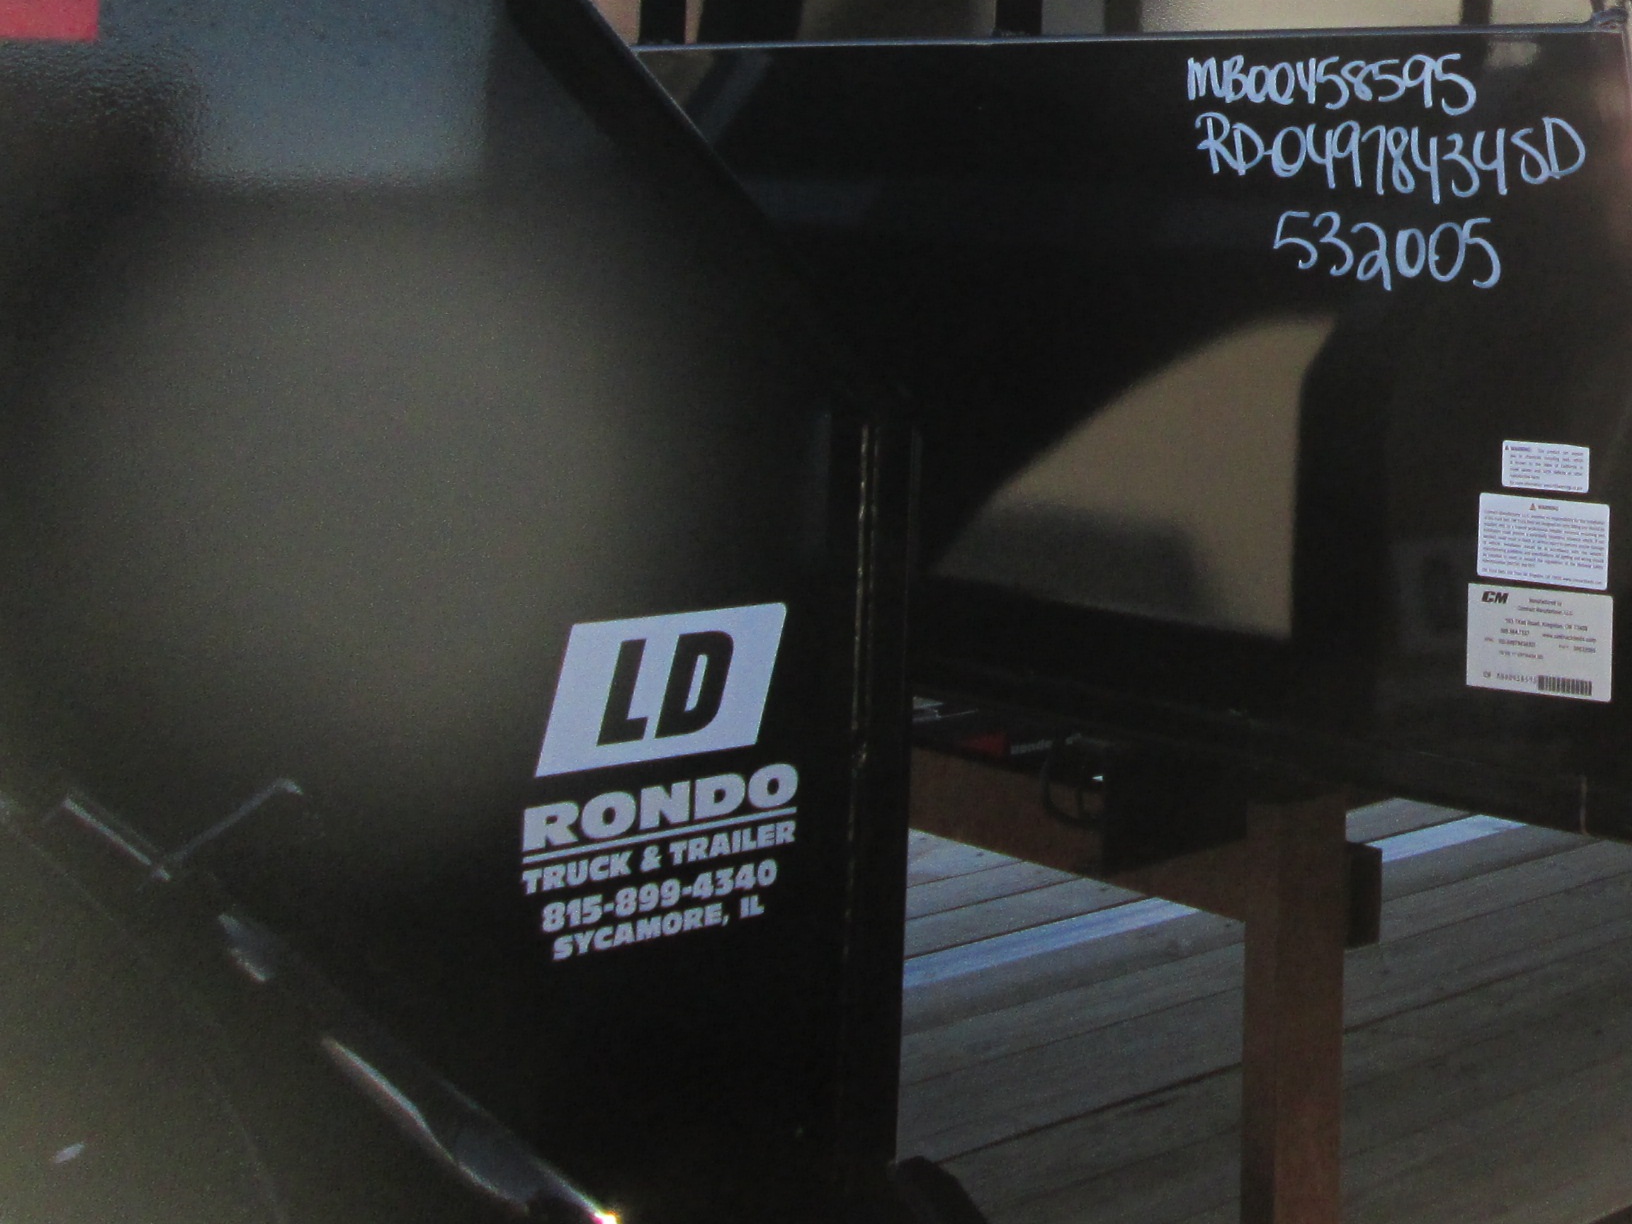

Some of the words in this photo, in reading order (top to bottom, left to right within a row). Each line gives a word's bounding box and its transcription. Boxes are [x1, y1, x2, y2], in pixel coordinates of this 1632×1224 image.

[1187, 53, 1477, 116] MB00458595
[1273, 210, 1501, 291] 532005
[1481, 589, 1510, 605] CM
[596, 630, 734, 747] LD
[522, 763, 799, 852] RONDO
[522, 852, 633, 895] TRUCK
[640, 845, 662, 872] &
[668, 820, 796, 866] TRAILER
[541, 858, 778, 933] 815-899-4340
[552, 902, 730, 961] SYCAMORE,
[740, 894, 765, 918] IL
